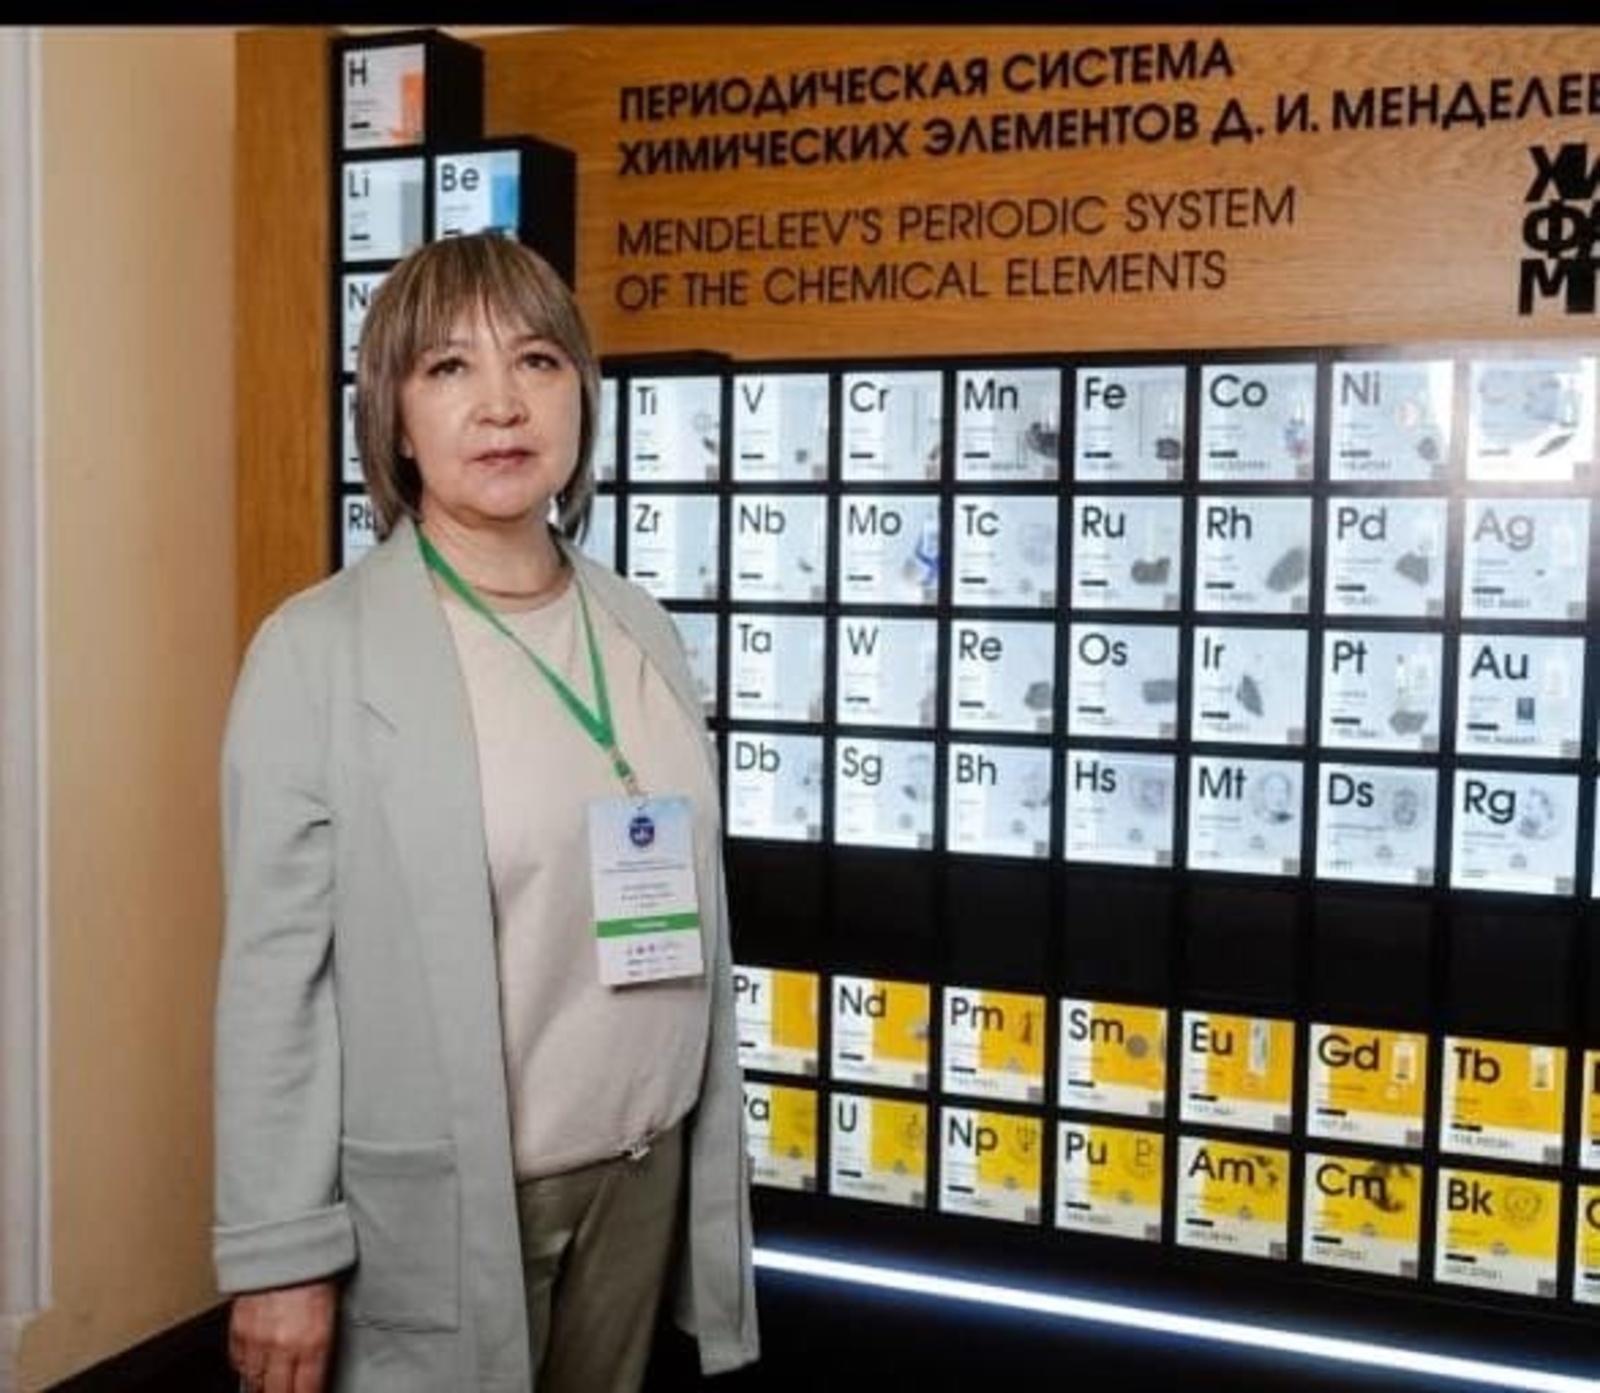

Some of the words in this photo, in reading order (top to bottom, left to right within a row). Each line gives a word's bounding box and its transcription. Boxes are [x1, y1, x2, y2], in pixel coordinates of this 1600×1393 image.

[348, 59, 367, 88] H
[620, 58, 988, 122] ПЕРИОДИЧЕСКАЯ
[1003, 38, 1234, 92] СИСТЕМА
[619, 121, 909, 176] ХИМИЧЕСКИХ
[923, 103, 1198, 156] ЭЛЕМЕНТОВ
[1211, 97, 1264, 145] Д.
[1275, 94, 1318, 134] И.
[348, 172, 369, 197] Li
[441, 164, 479, 192] Be
[617, 207, 881, 256] MENDELEEV'S
[899, 196, 1106, 242] PERIODIC
[1125, 185, 1295, 232] SYSTEM
[615, 274, 669, 312] OF
[684, 269, 749, 307] THE
[764, 261, 989, 304] CHEMICAL
[1007, 250, 1226, 296] ELEMENTS
[636, 387, 657, 415] Ti
[743, 385, 764, 413] V
[849, 382, 889, 413] Cr
[964, 379, 1018, 411] Mn
[1085, 377, 1127, 409] Fe
[1210, 375, 1268, 407] Co
[1342, 372, 1380, 406] Ni
[634, 505, 660, 533] Zr
[740, 505, 785, 534] Nb
[848, 506, 901, 535] Mo
[961, 505, 999, 536] Tc
[1082, 507, 1125, 538] Ru
[1207, 507, 1252, 539] Rh
[1337, 506, 1387, 540] Pd
[1473, 509, 1534, 550] Ag
[738, 624, 771, 653] Ta
[847, 627, 878, 654] W
[960, 630, 1001, 661] Re
[1079, 634, 1127, 665] Os
[1203, 637, 1225, 668] Ir
[1331, 641, 1367, 674] Pt
[1471, 646, 1528, 680] Au
[736, 742, 779, 771] Db
[842, 747, 882, 785] Sg
[957, 754, 997, 785] Bh
[1075, 762, 1116, 792] Hs
[1200, 767, 1246, 799] Mt
[1329, 774, 1374, 807] Ds
[1464, 781, 1516, 824] Rg
[839, 986, 886, 1018] Nd
[951, 998, 1003, 1031] Pm
[1069, 1009, 1123, 1043] Sm
[1191, 1022, 1233, 1055] Eu
[1318, 1035, 1379, 1071] Gd
[1455, 1047, 1500, 1084] Tb
[839, 1103, 857, 1132] U
[949, 1119, 997, 1155] Np
[1066, 1132, 1107, 1166] Pu
[1189, 1149, 1254, 1184] Am
[1316, 1164, 1387, 1200] Cm
[1448, 1178, 1493, 1216] Bk
